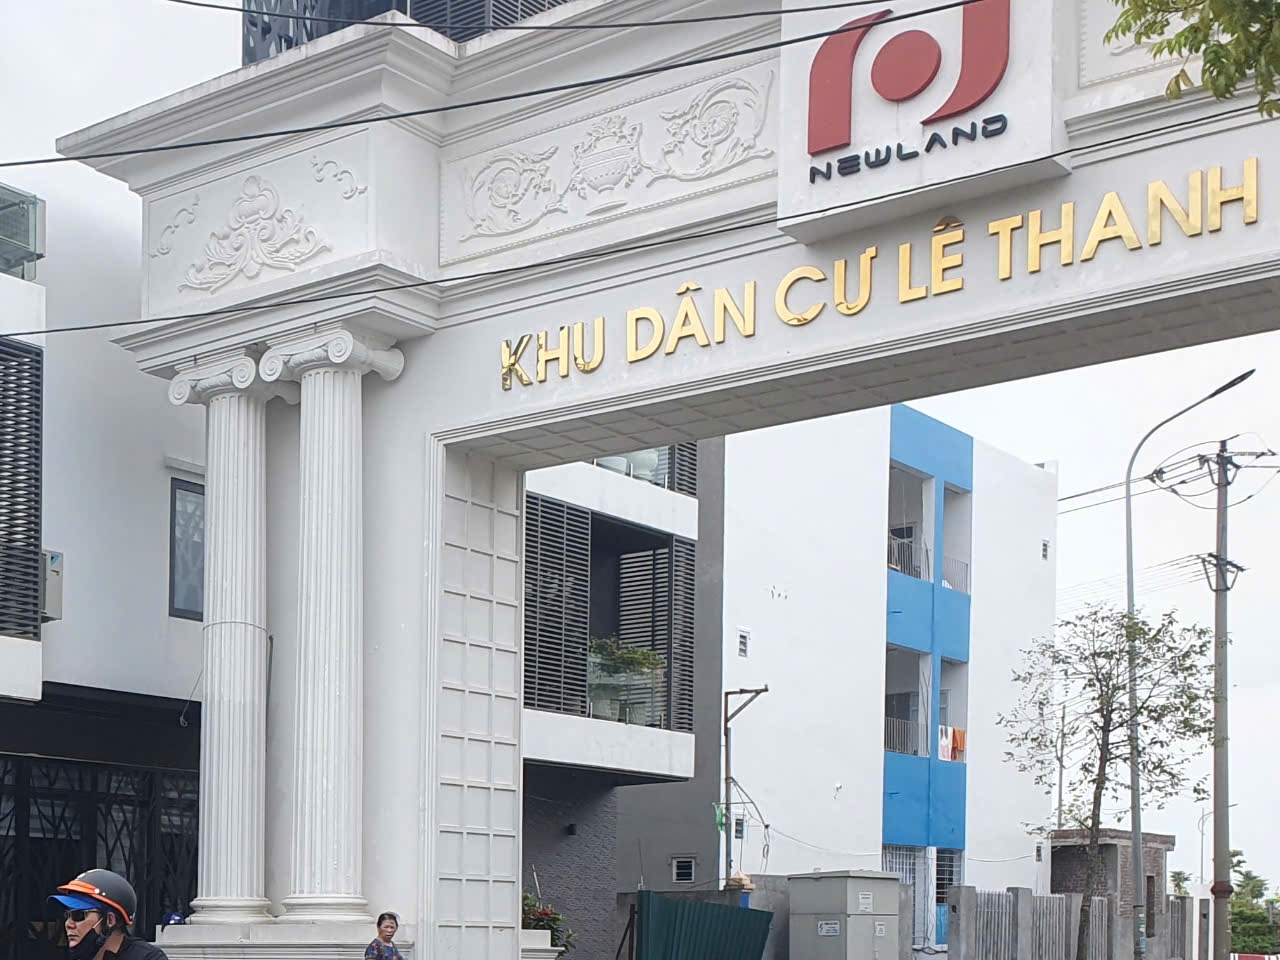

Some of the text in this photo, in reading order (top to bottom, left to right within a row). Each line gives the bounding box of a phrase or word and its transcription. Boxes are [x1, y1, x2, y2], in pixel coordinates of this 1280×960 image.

[809, 114, 1008, 184] NEWLAND
[501, 157, 1259, 390] KHU DÂN CƯ LÊ THANH
